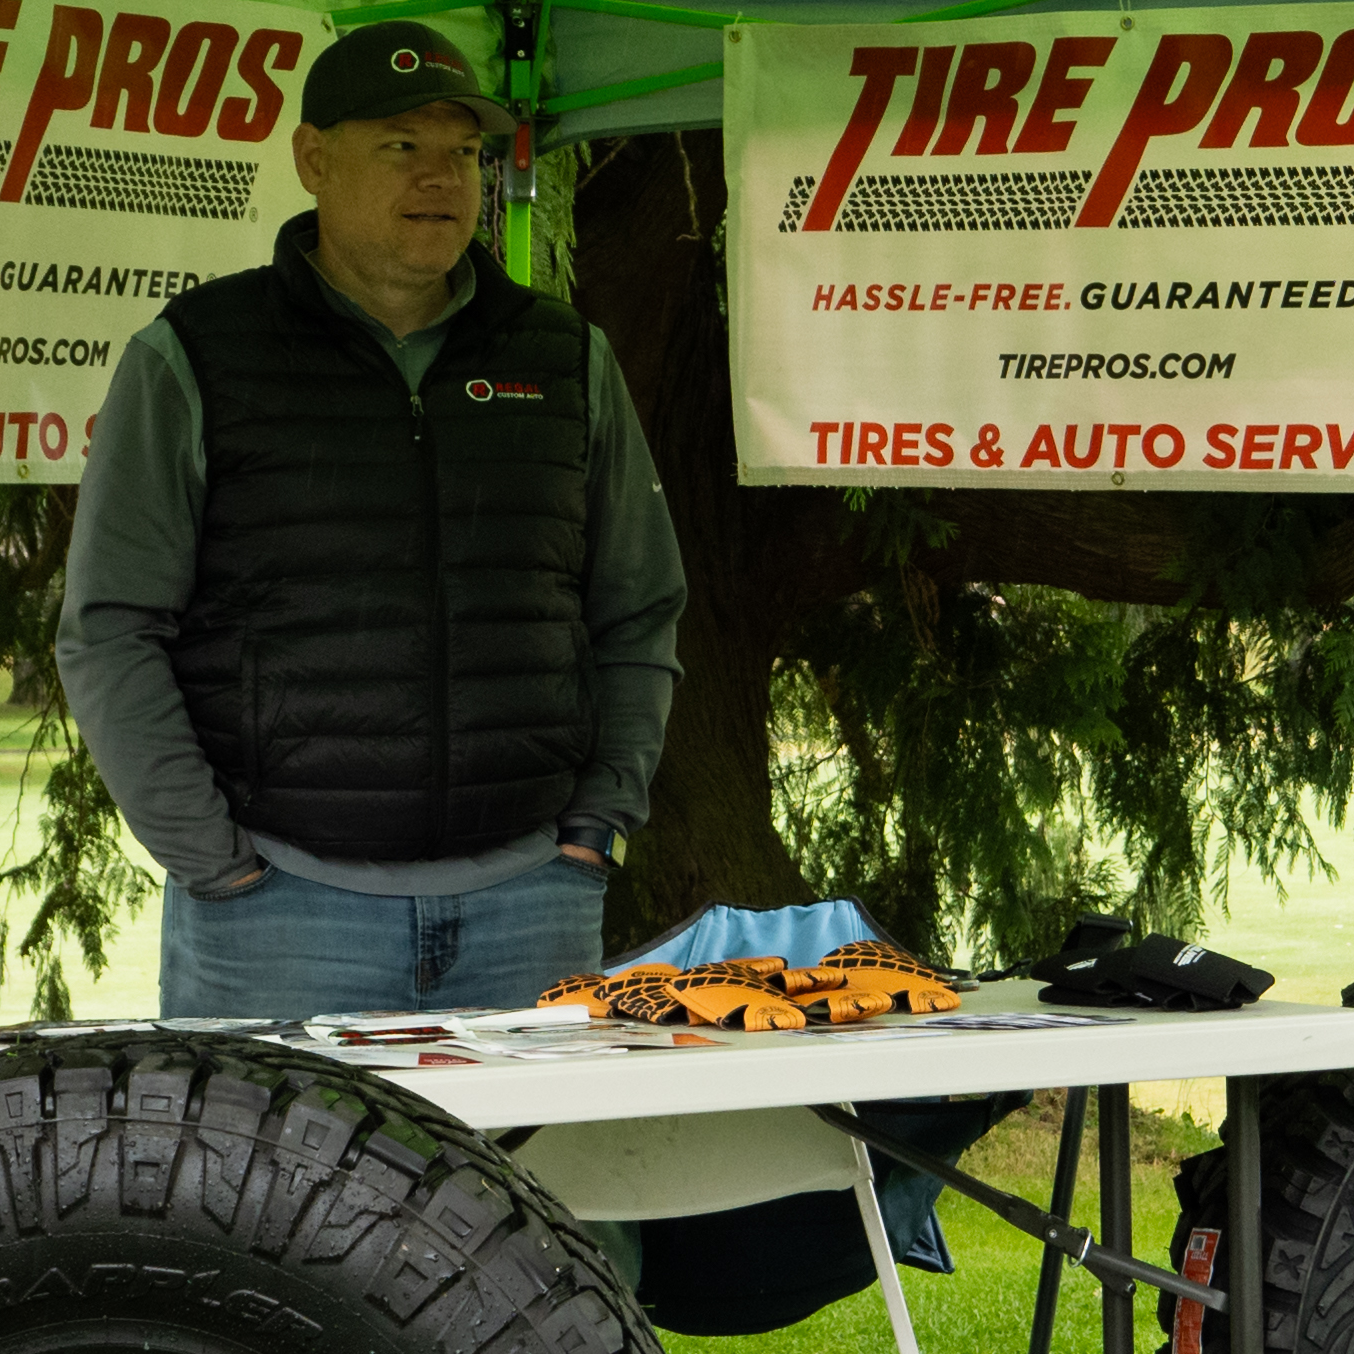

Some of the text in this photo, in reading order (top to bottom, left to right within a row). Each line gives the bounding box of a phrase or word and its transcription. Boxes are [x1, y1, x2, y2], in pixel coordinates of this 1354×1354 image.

[0, 5, 302, 202] PROS
[802, 37, 1117, 231] TIRE
[813, 284, 1070, 310] HASSLE-FREE.
[1000, 353, 1236, 379] TIREPROS.COM
[495, 382, 540, 393] REGAL
[496, 392, 525, 400] CUSTOM
[810, 422, 954, 467] TIRES
[970, 424, 1004, 468] &
[1020, 424, 1185, 469] AUTO
